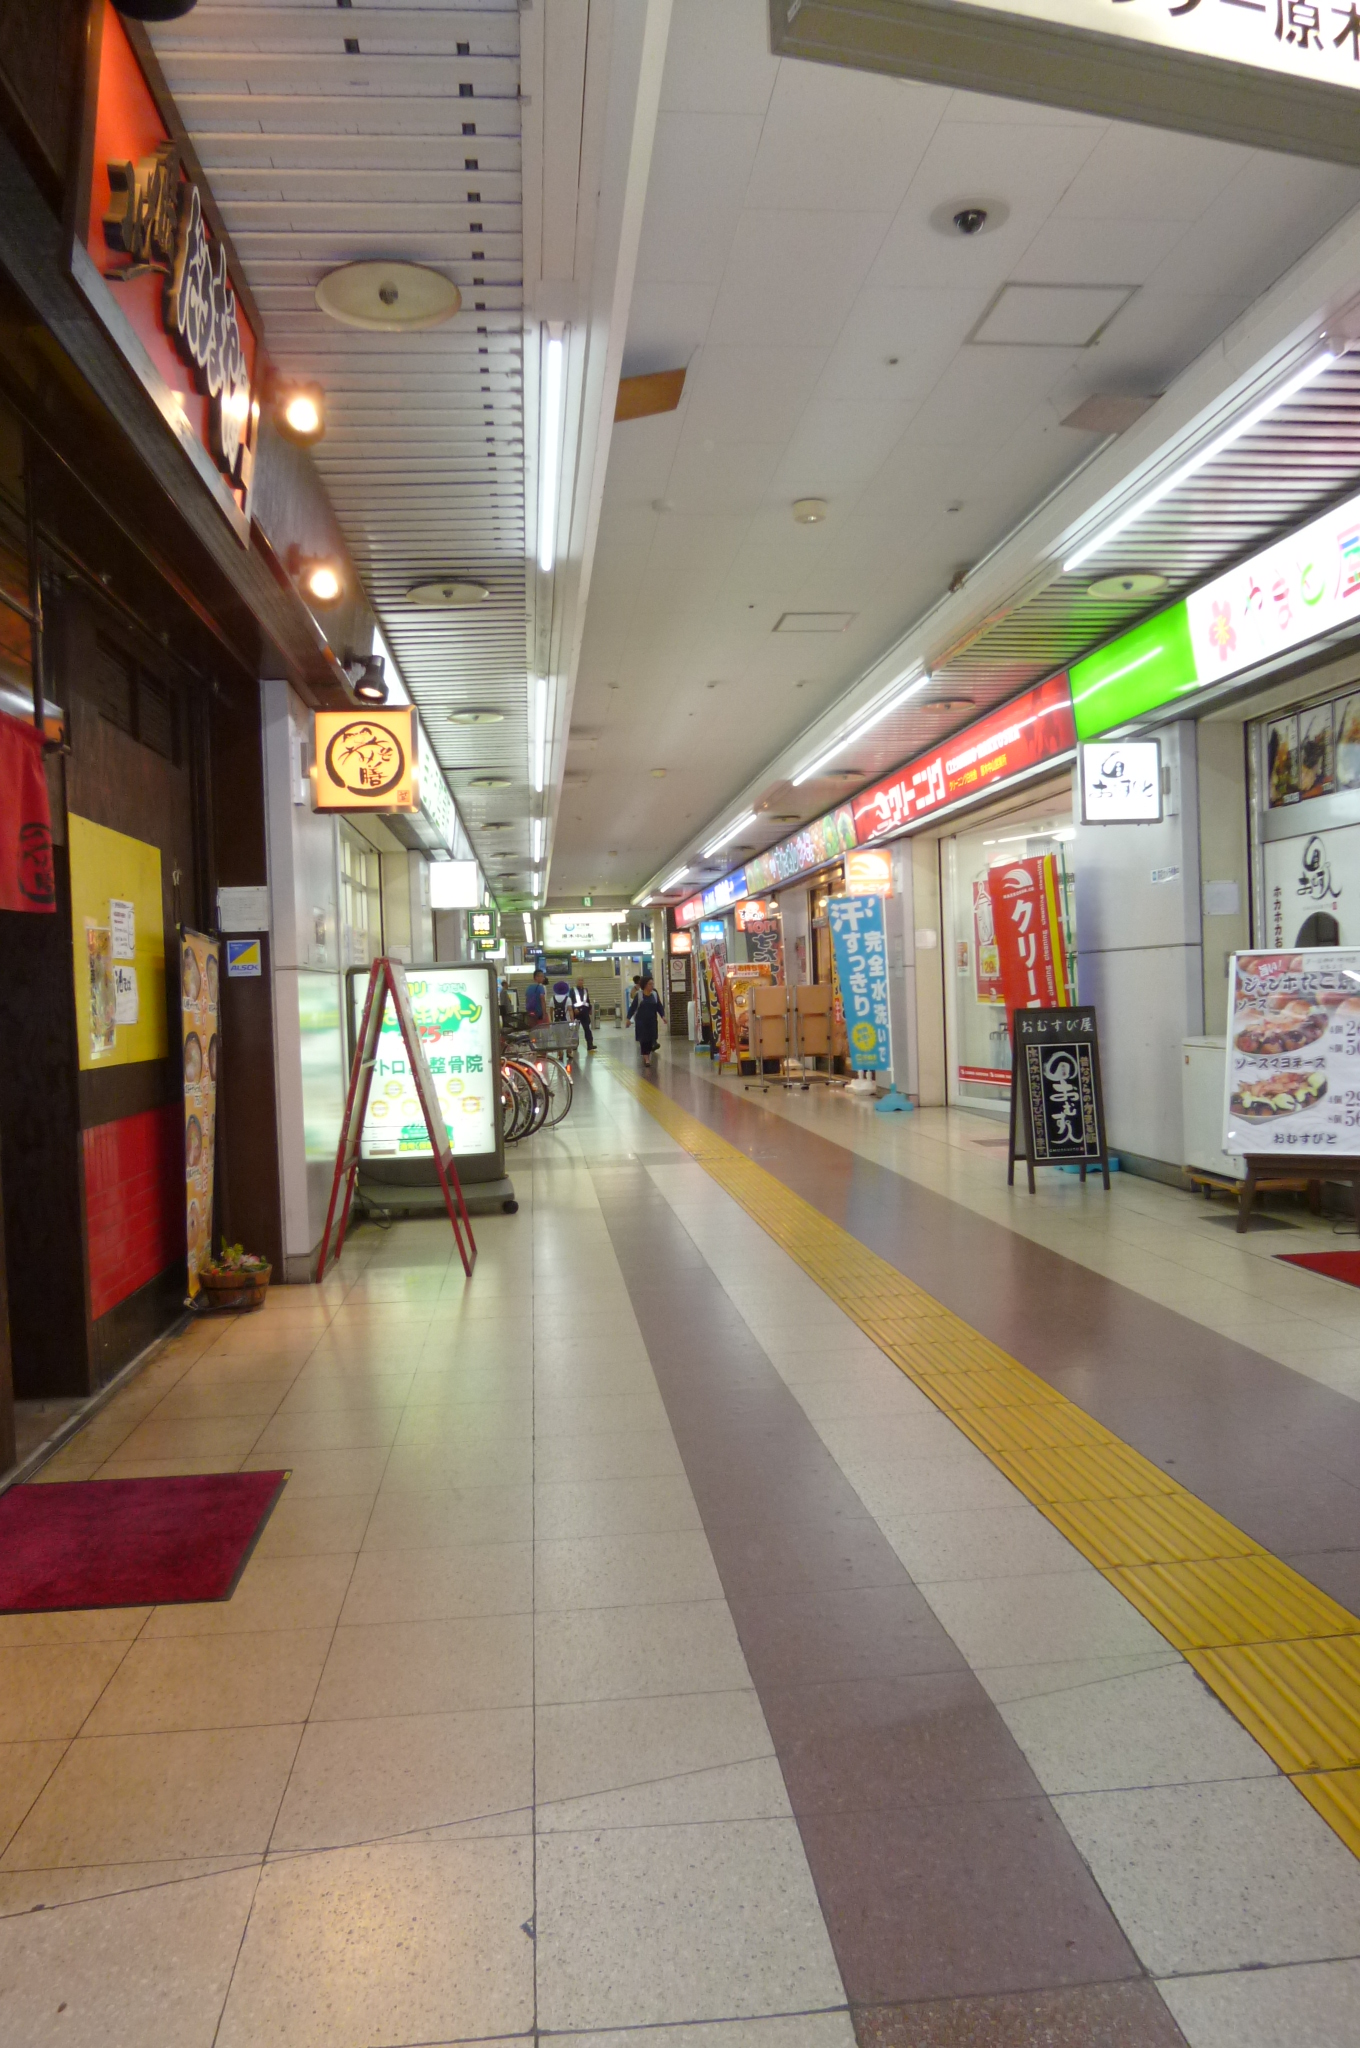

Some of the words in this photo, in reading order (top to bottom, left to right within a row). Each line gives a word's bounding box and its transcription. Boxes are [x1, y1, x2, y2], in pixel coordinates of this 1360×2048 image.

[863, 930, 888, 1064] 完全水洗いで
[1238, 1000, 1268, 1011] ソース
[1021, 1016, 1094, 1034] おむすび屋
[1274, 1133, 1337, 1145] おむすびと
